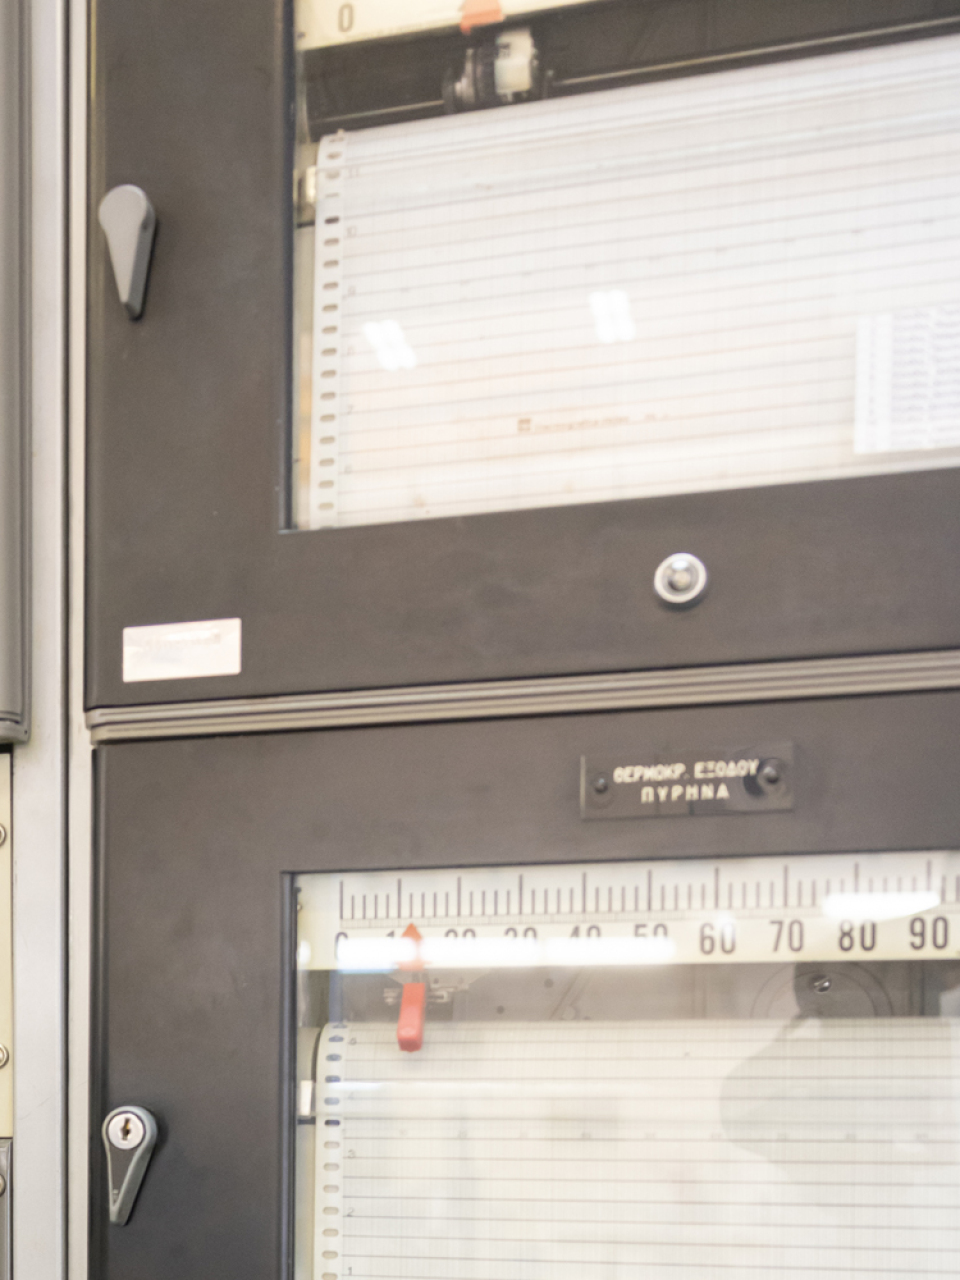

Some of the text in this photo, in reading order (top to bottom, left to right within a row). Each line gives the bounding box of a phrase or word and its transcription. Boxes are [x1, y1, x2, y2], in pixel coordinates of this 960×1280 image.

[769, 919, 804, 953] 70
[838, 919, 877, 952] 80
[910, 916, 949, 951] 90
